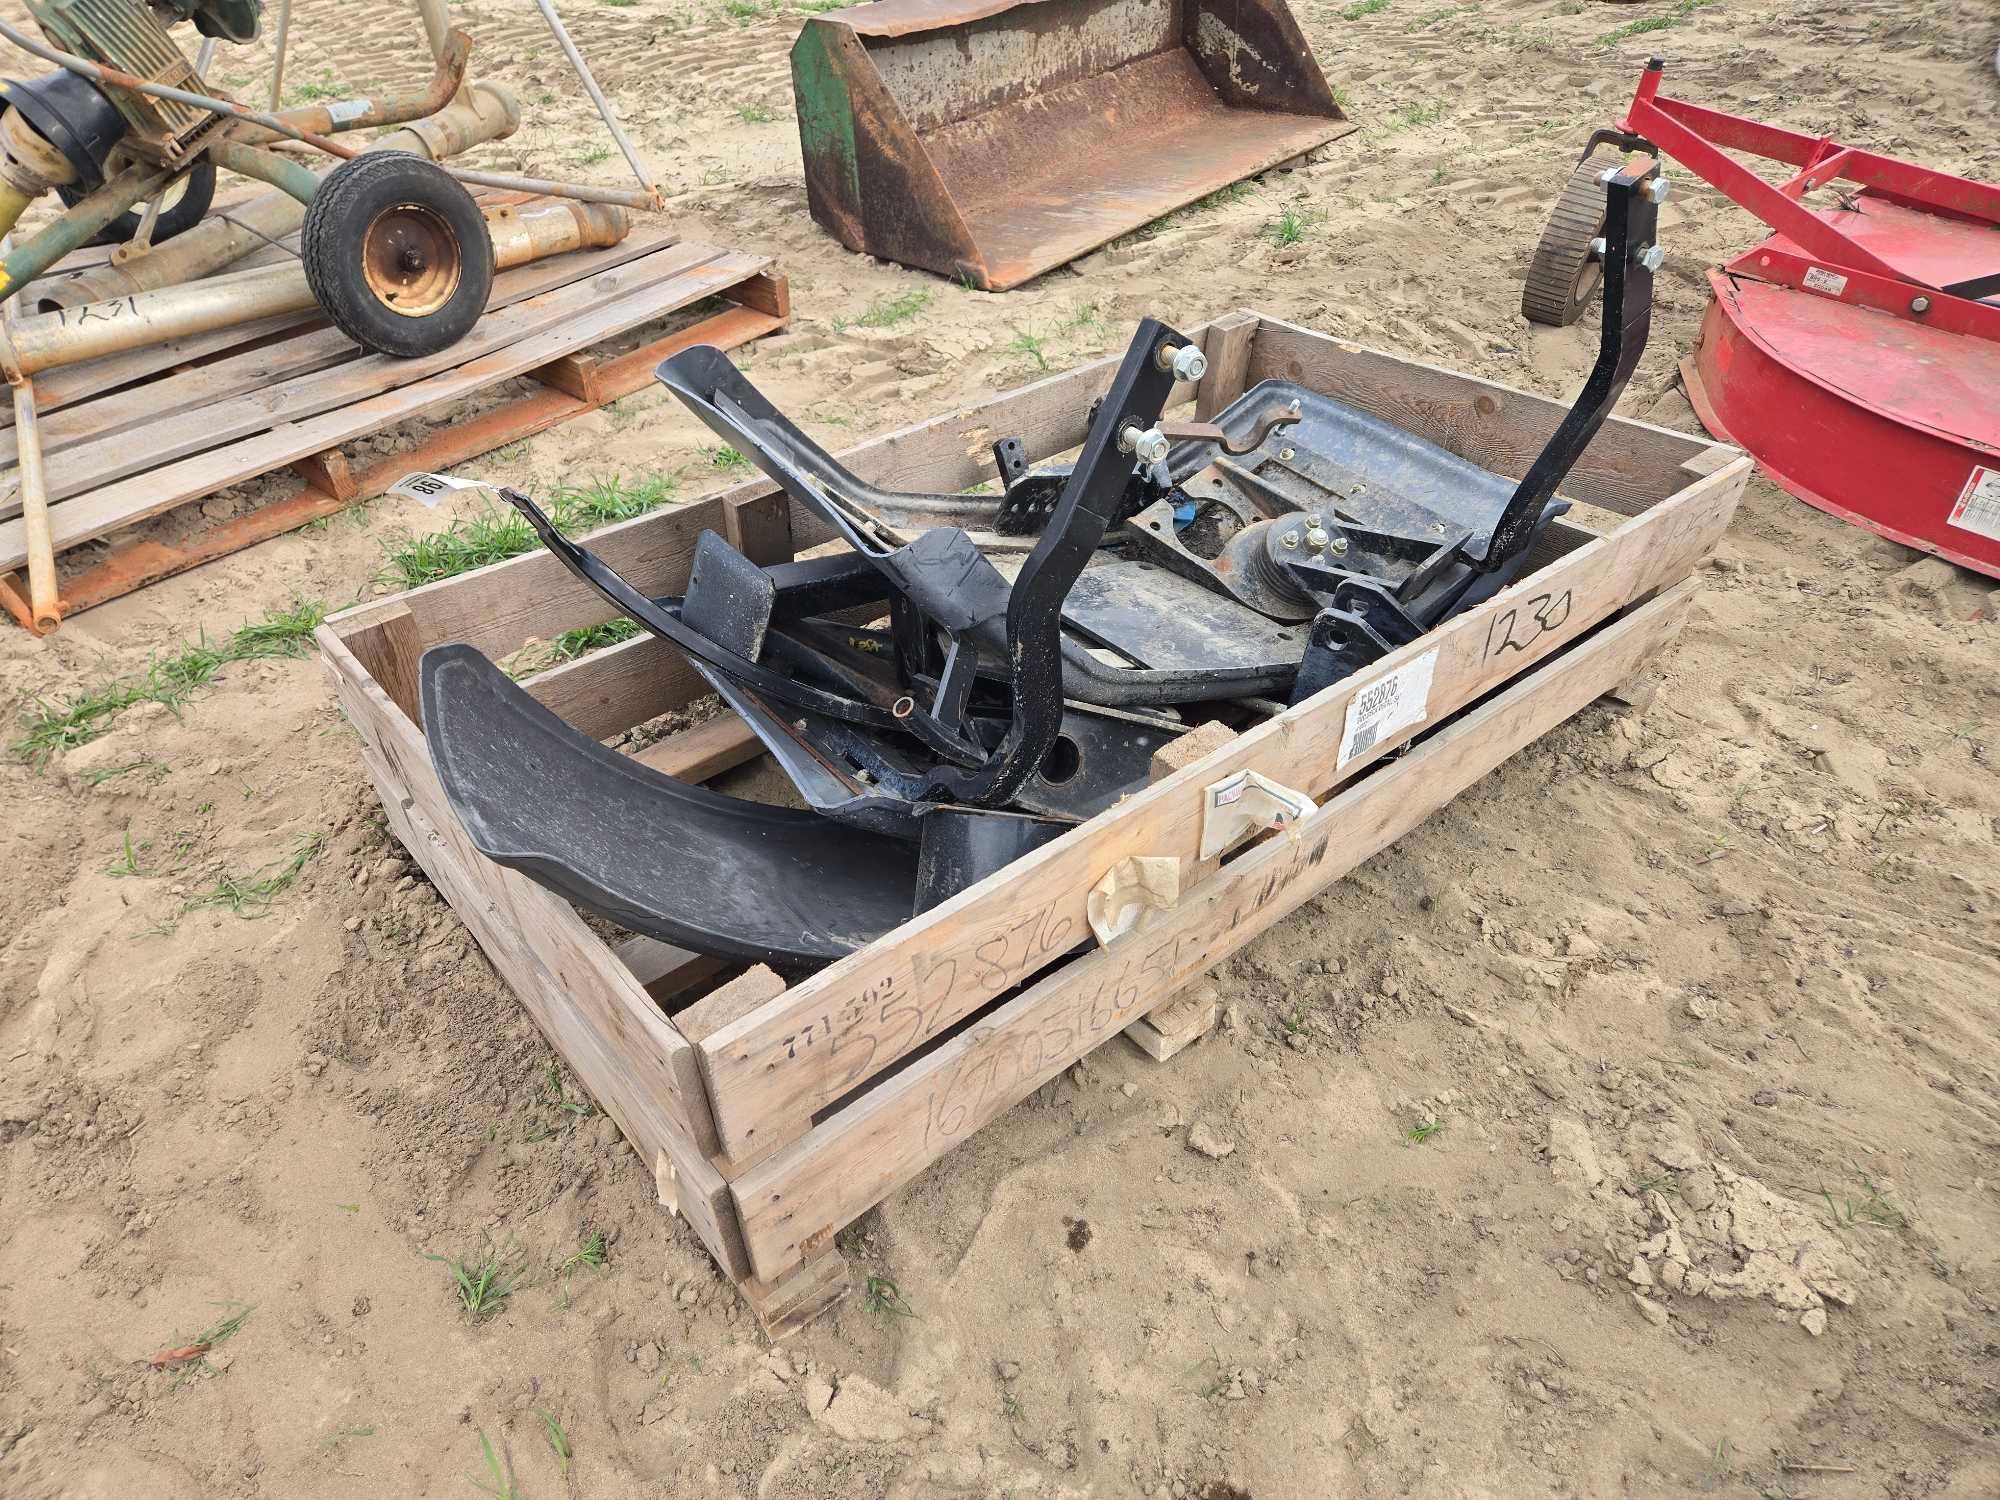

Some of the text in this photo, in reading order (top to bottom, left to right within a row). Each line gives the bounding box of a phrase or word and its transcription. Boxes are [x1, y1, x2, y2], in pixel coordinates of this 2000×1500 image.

[1481, 588, 1571, 669] 1230
[1359, 675, 1399, 716] 552876
[815, 901, 1072, 1097] 552876
